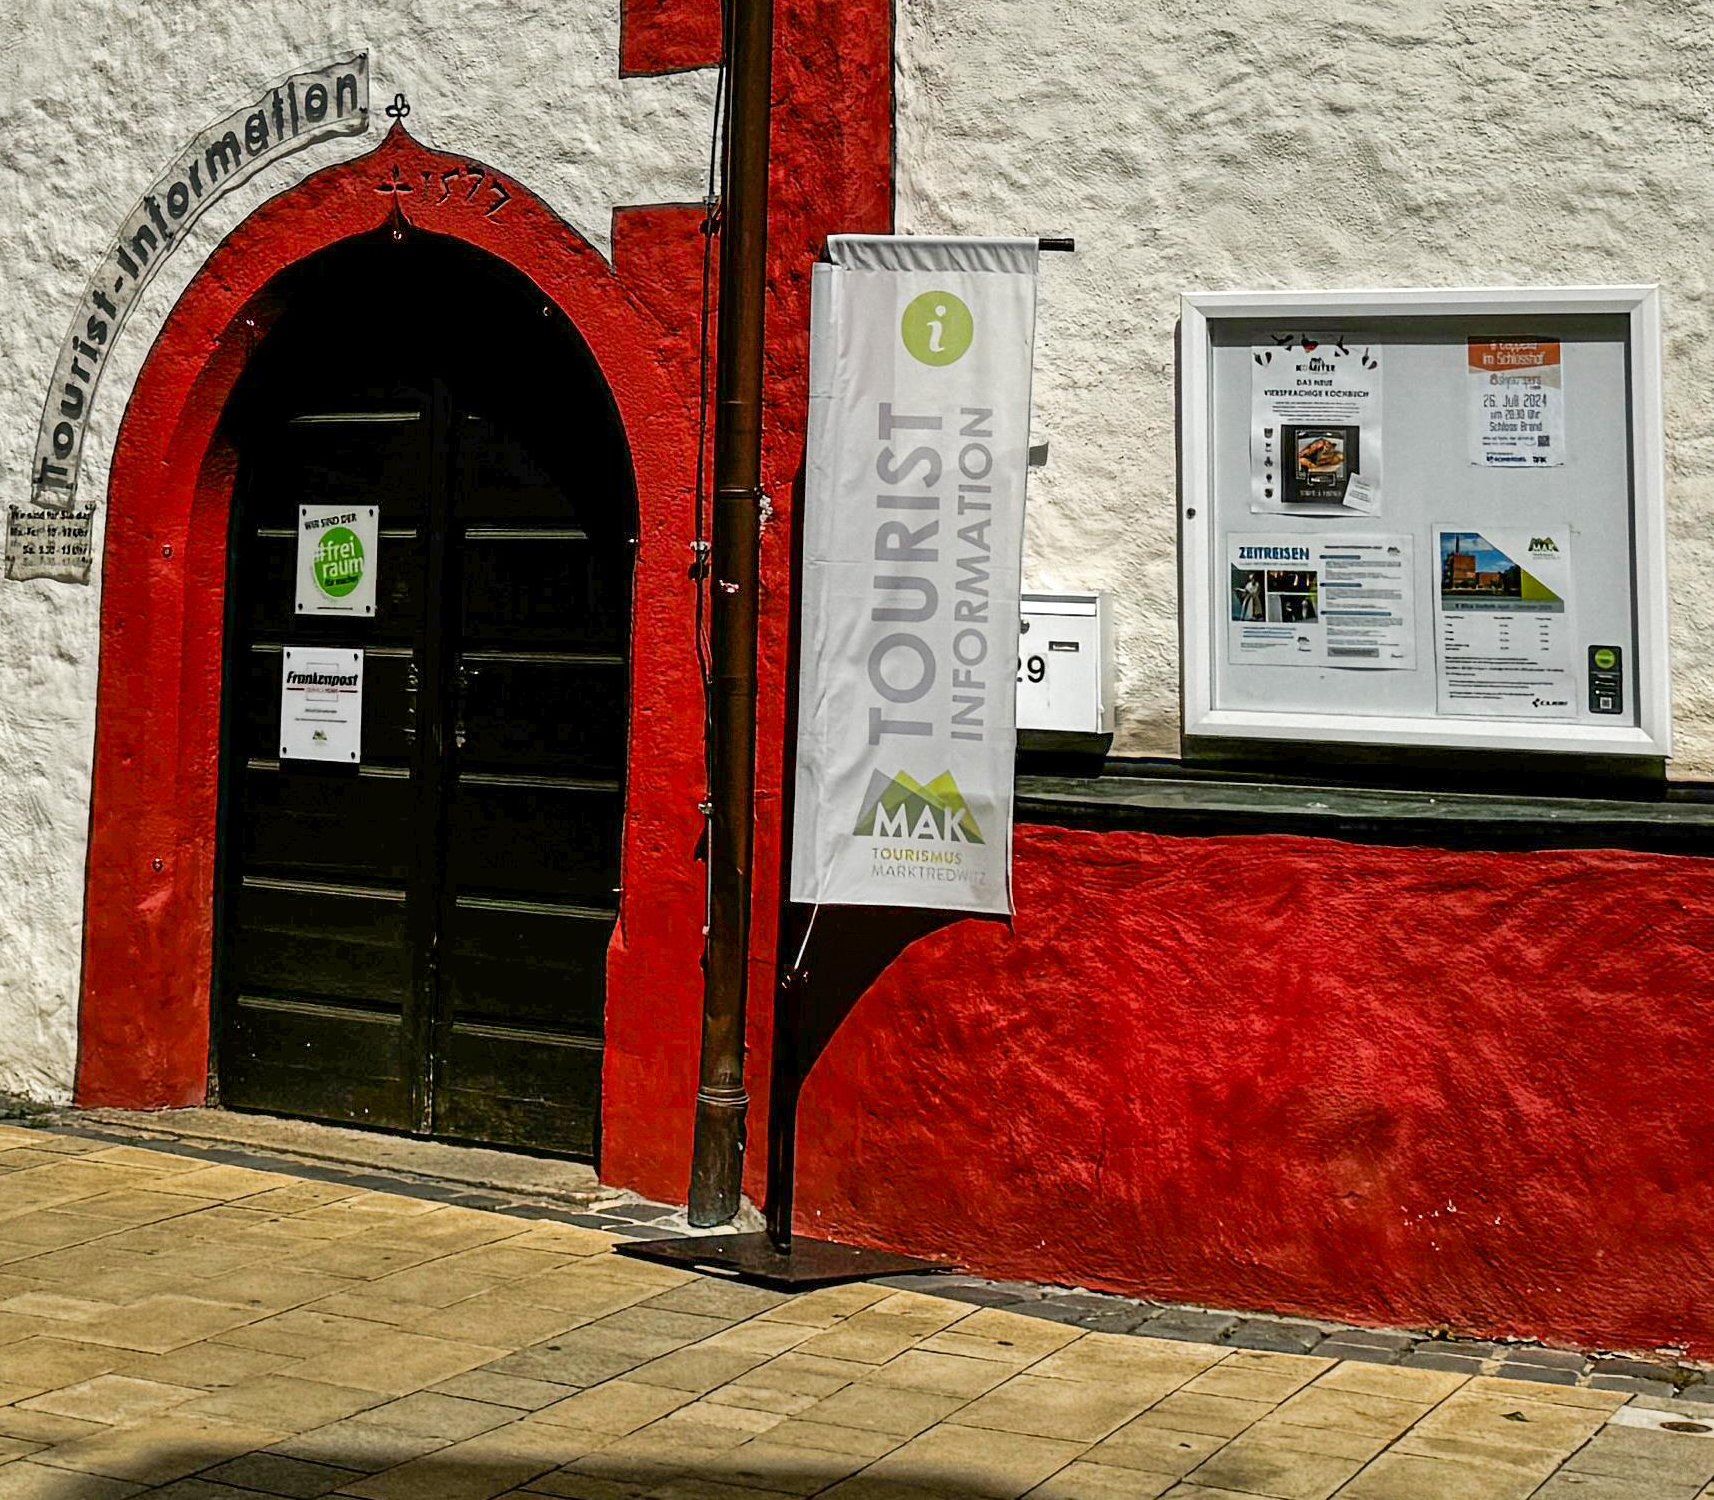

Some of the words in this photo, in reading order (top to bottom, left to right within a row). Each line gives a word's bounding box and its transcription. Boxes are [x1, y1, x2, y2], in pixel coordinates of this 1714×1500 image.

[1523, 394, 1547, 408] 2024
[1239, 546, 1310, 560] ZEITREISEN
[322, 556, 364, 581] raum
[867, 401, 944, 747] TOURIST
[950, 406, 994, 742] INFORMATION
[872, 801, 970, 843] MAK
[871, 847, 964, 866] TOURISMUS
